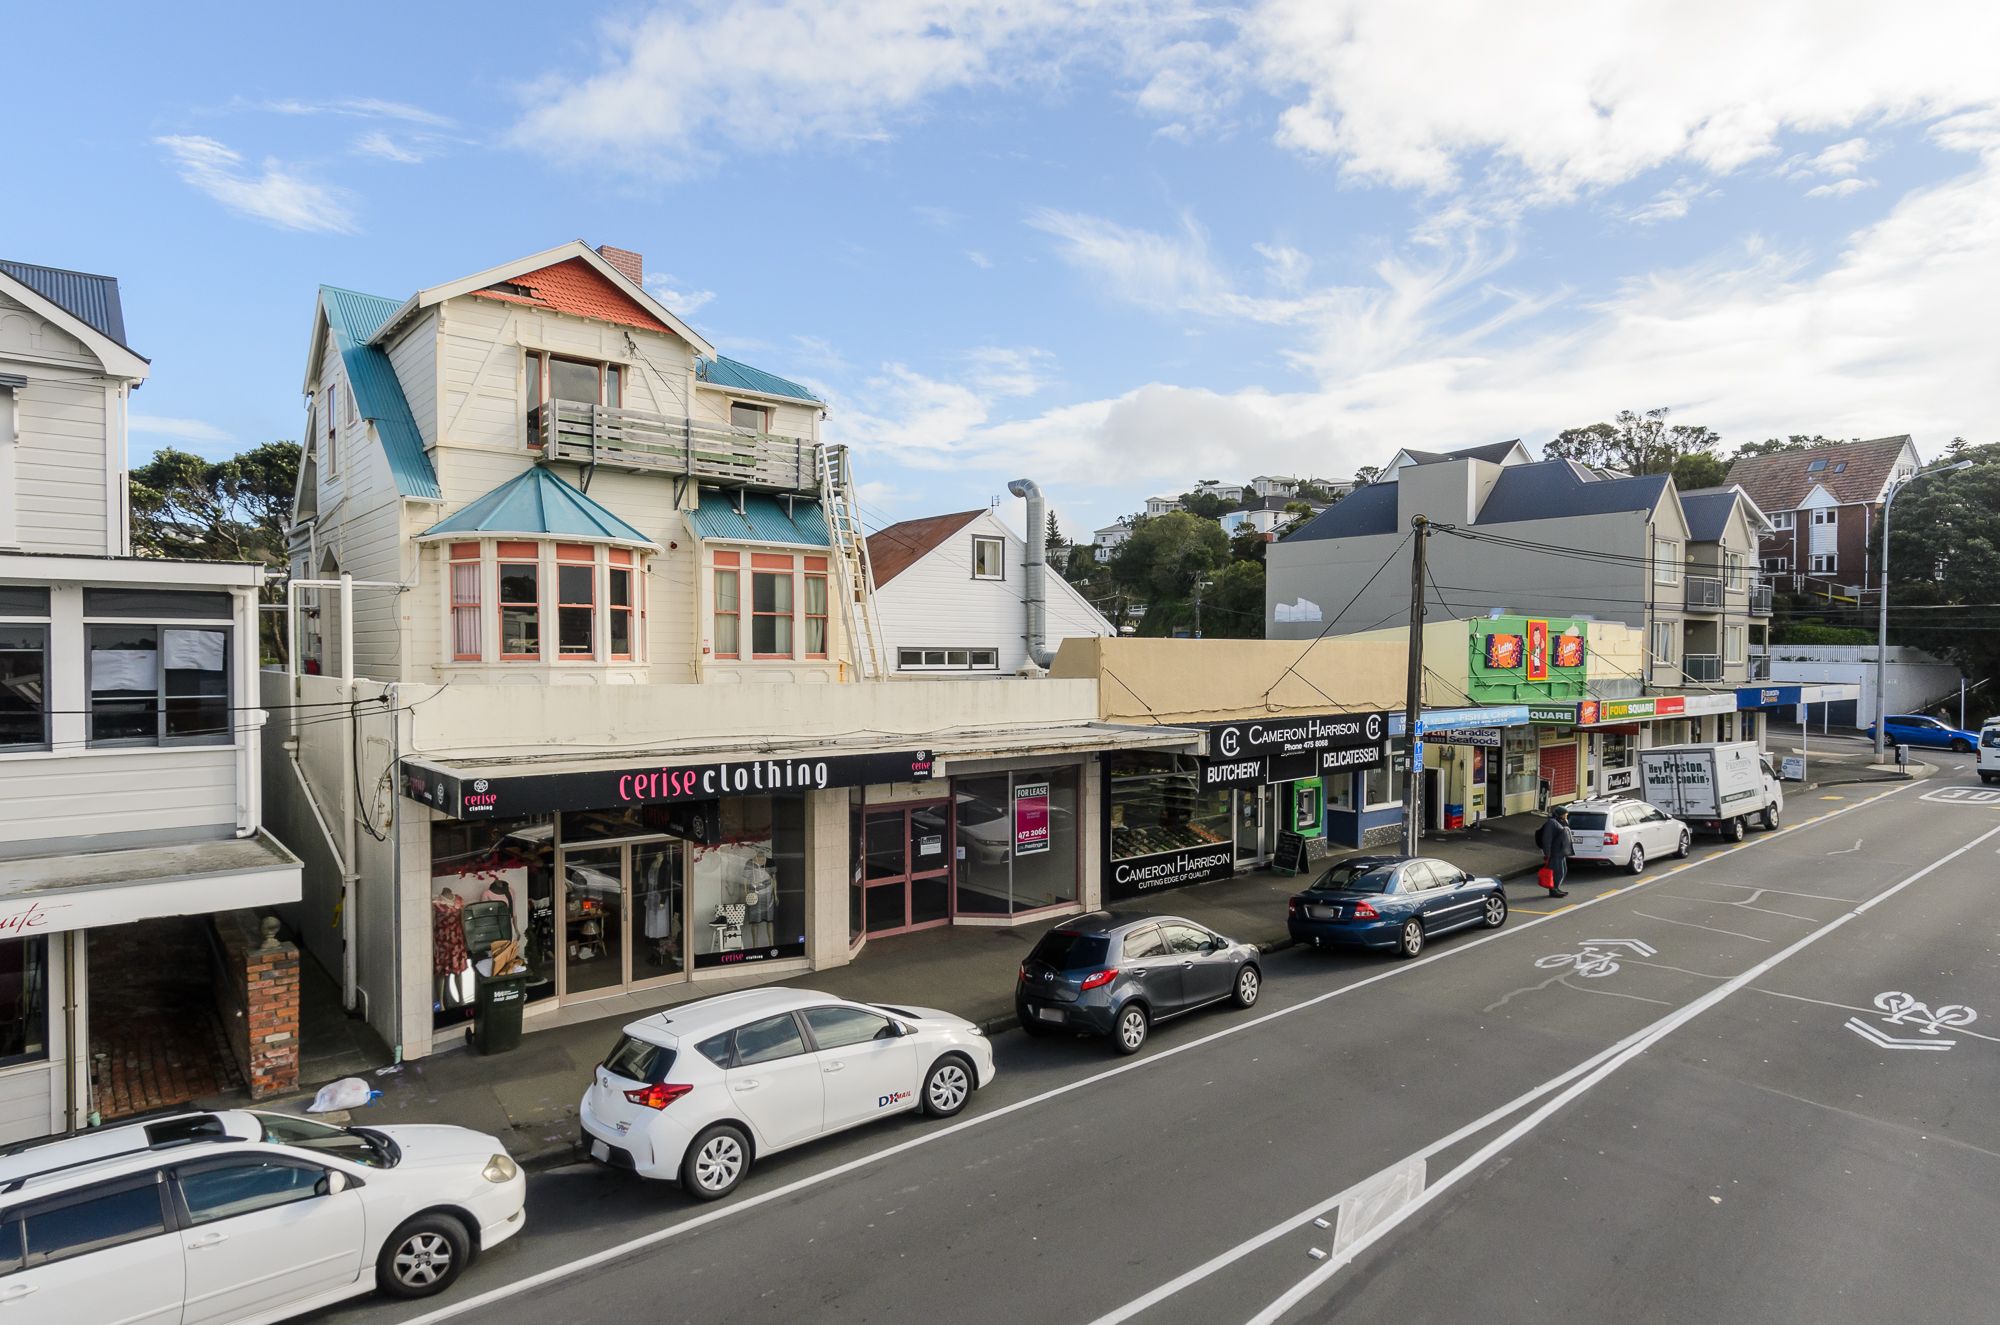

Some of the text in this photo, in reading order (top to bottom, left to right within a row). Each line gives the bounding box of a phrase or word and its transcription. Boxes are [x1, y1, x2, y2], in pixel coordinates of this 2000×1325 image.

[1497, 642, 1513, 654] Lotto
[1563, 642, 1576, 654] Lotto
[1609, 704, 1627, 716] FOUR
[1628, 702, 1654, 714] SQUARE
[1528, 711, 1572, 720] QUARE
[1249, 720, 1360, 744] CAMERON HARRISON
[1450, 729, 1497, 738] Paradise
[1284, 740, 1328, 751] Phone 475 8068
[1449, 736, 1499, 746] Seafoods
[1323, 747, 1379, 768] DELICATESSEN
[1207, 761, 1261, 783] BUTCHERY
[1648, 763, 1662, 775] Hey
[619, 759, 828, 801] cerise clothing
[1017, 787, 1047, 798] FOR LEASE
[464, 793, 497, 806] cerise
[469, 804, 493, 812] clothing
[1018, 831, 1029, 839] 472
[1030, 826, 1047, 837] 2066
[1115, 853, 1230, 884] CAMERON HARRISON
[1138, 868, 1211, 889] CUTTING EDGE OF QUALITY
[721, 952, 744, 963] cerise
